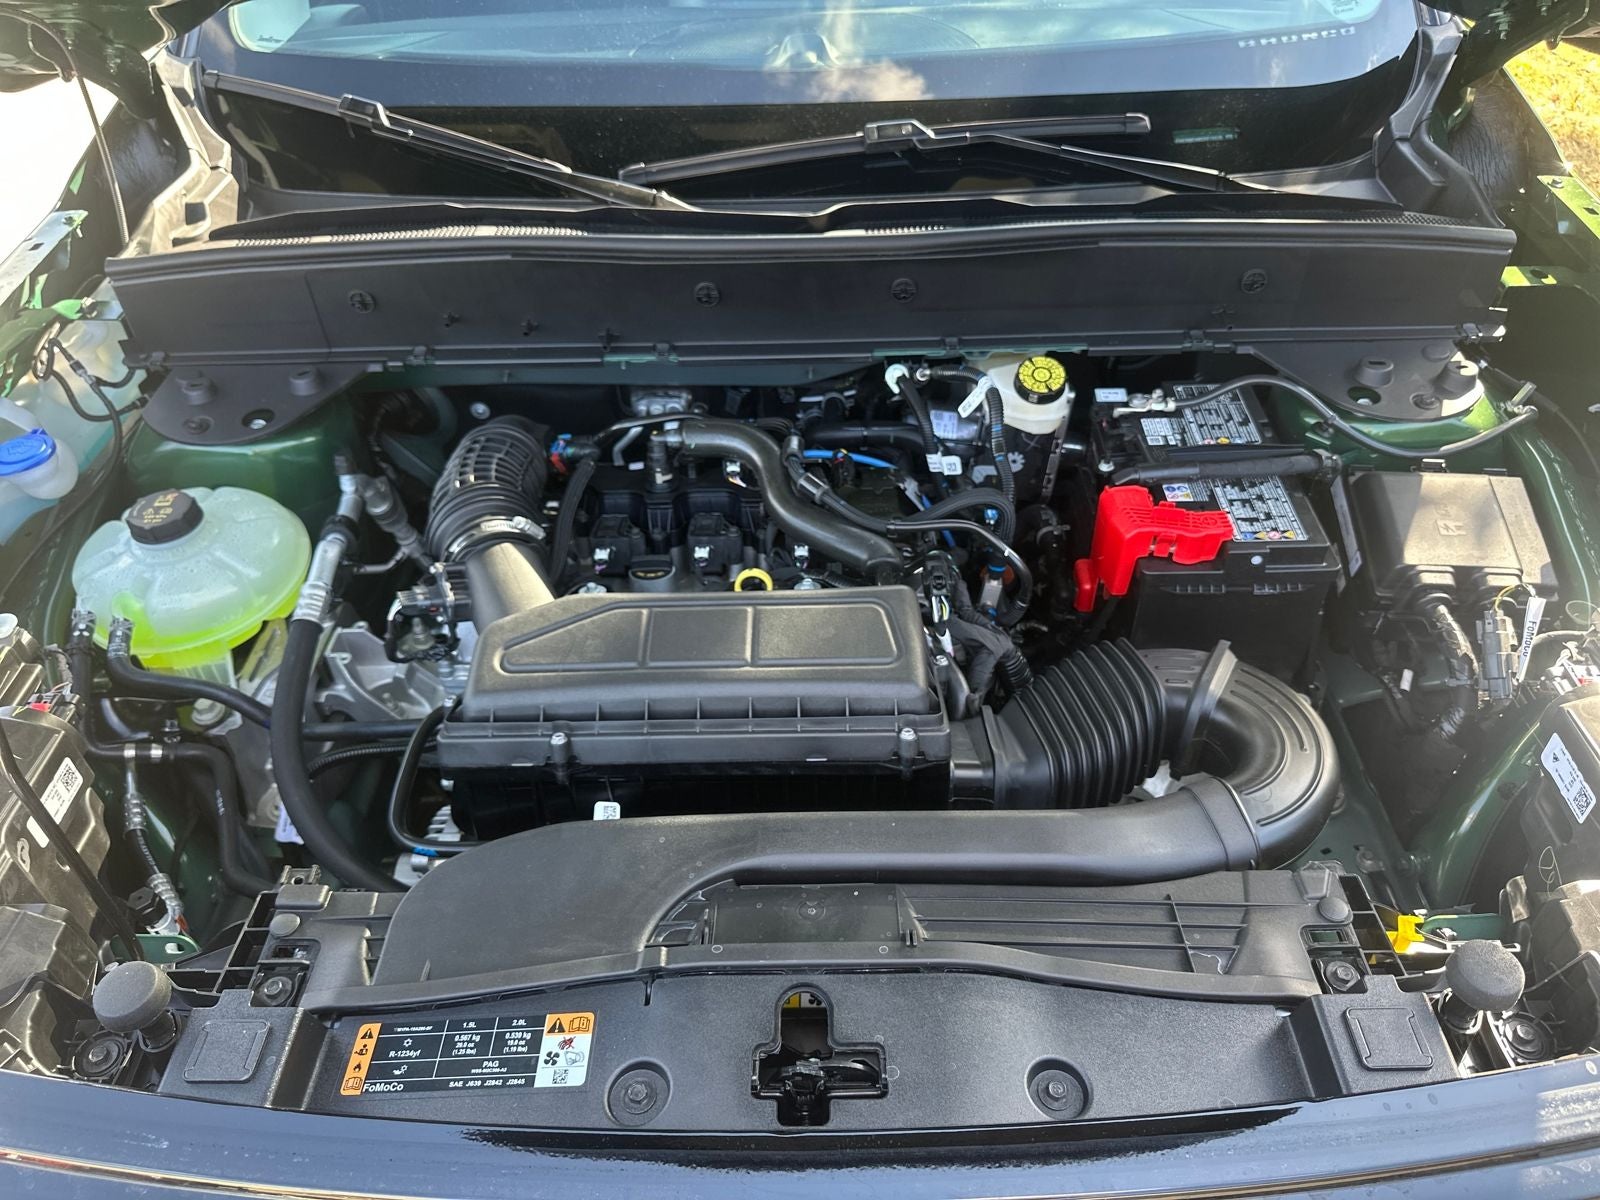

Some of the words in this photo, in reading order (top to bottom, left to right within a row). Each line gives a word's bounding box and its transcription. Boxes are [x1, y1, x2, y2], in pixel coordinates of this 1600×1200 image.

[388, 1049, 422, 1058] R-1234yf
[482, 1060, 500, 1068] PAG
[362, 1082, 404, 1092] FoMoCo
